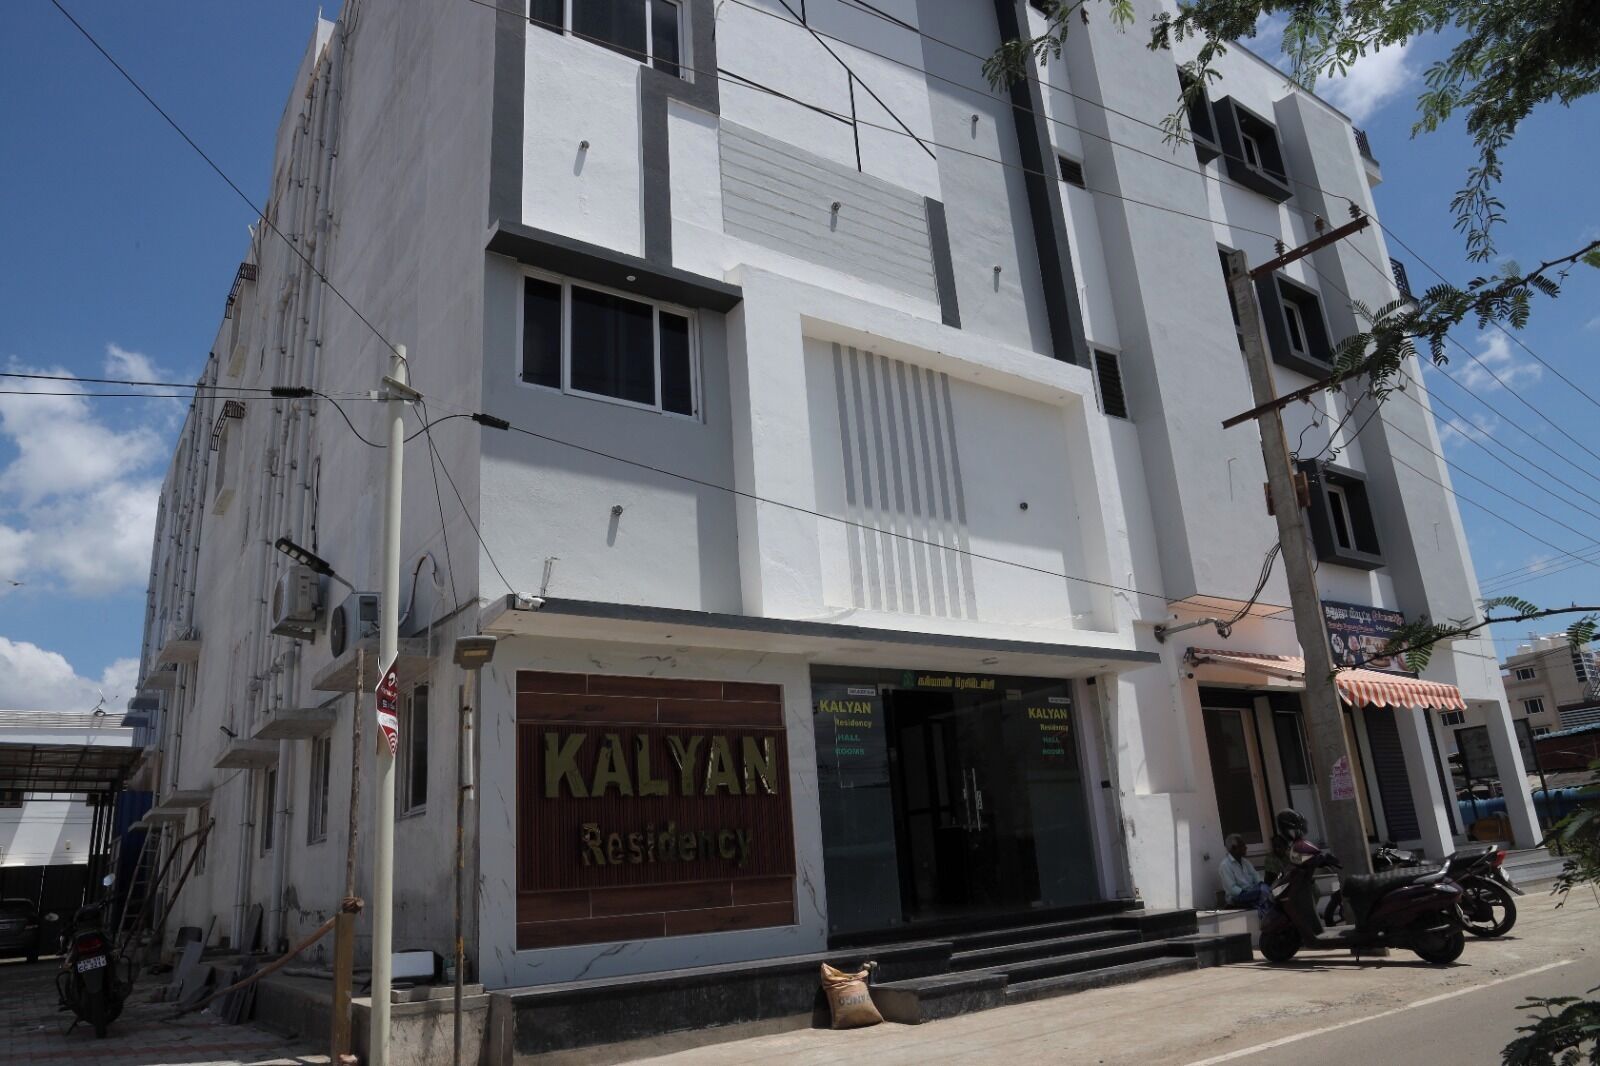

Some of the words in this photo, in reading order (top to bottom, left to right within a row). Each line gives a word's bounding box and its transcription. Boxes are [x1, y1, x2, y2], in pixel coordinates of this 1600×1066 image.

[819, 699, 872, 714] KALYAN
[1028, 707, 1068, 719] KALYAN
[834, 718, 872, 729] Residency
[837, 734, 861, 742] HALL
[544, 732, 778, 798] KALYAN
[580, 821, 751, 868] Residency
